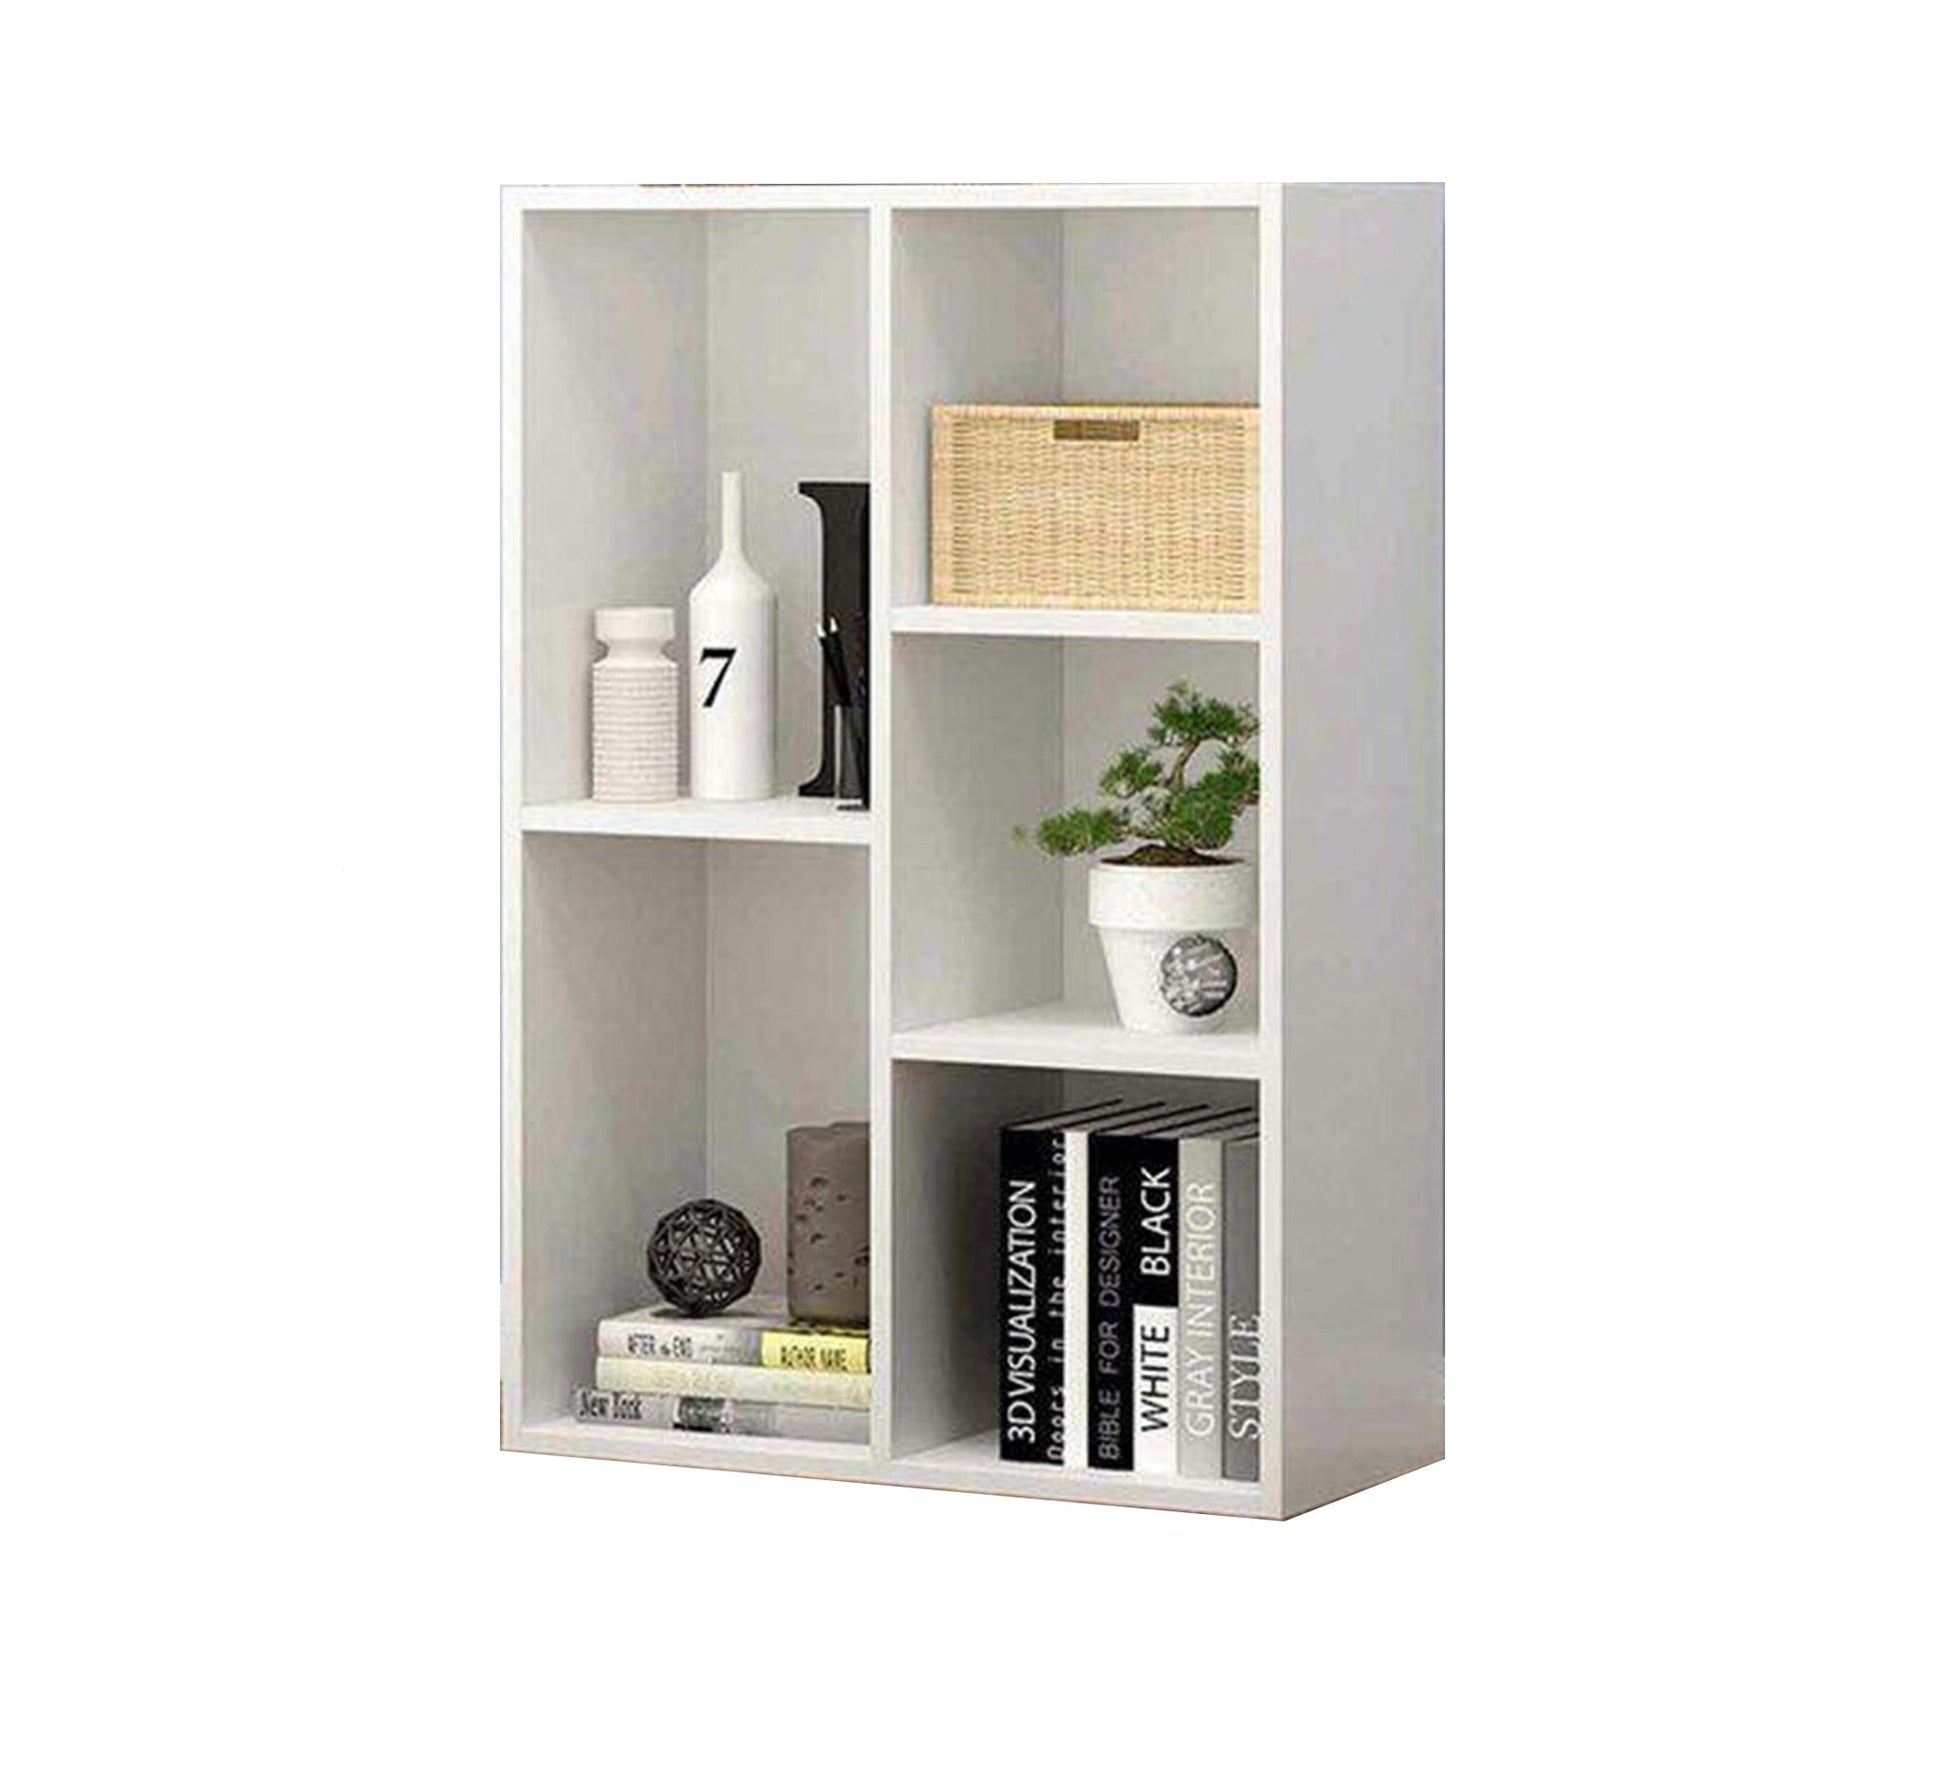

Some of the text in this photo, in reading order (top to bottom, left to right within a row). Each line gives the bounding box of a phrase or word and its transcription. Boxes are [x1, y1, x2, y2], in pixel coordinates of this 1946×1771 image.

[699, 646, 736, 708] 7
[1139, 1166, 1171, 1277] BLACK
[1099, 1174, 1122, 1461] BIBLE FOR DESIGNER
[1183, 1182, 1216, 1437] GRAY INTERIOR
[578, 1390, 608, 1418] New
[1139, 1325, 1170, 1433] WHITE
[1229, 1313, 1263, 1440] STYLE
